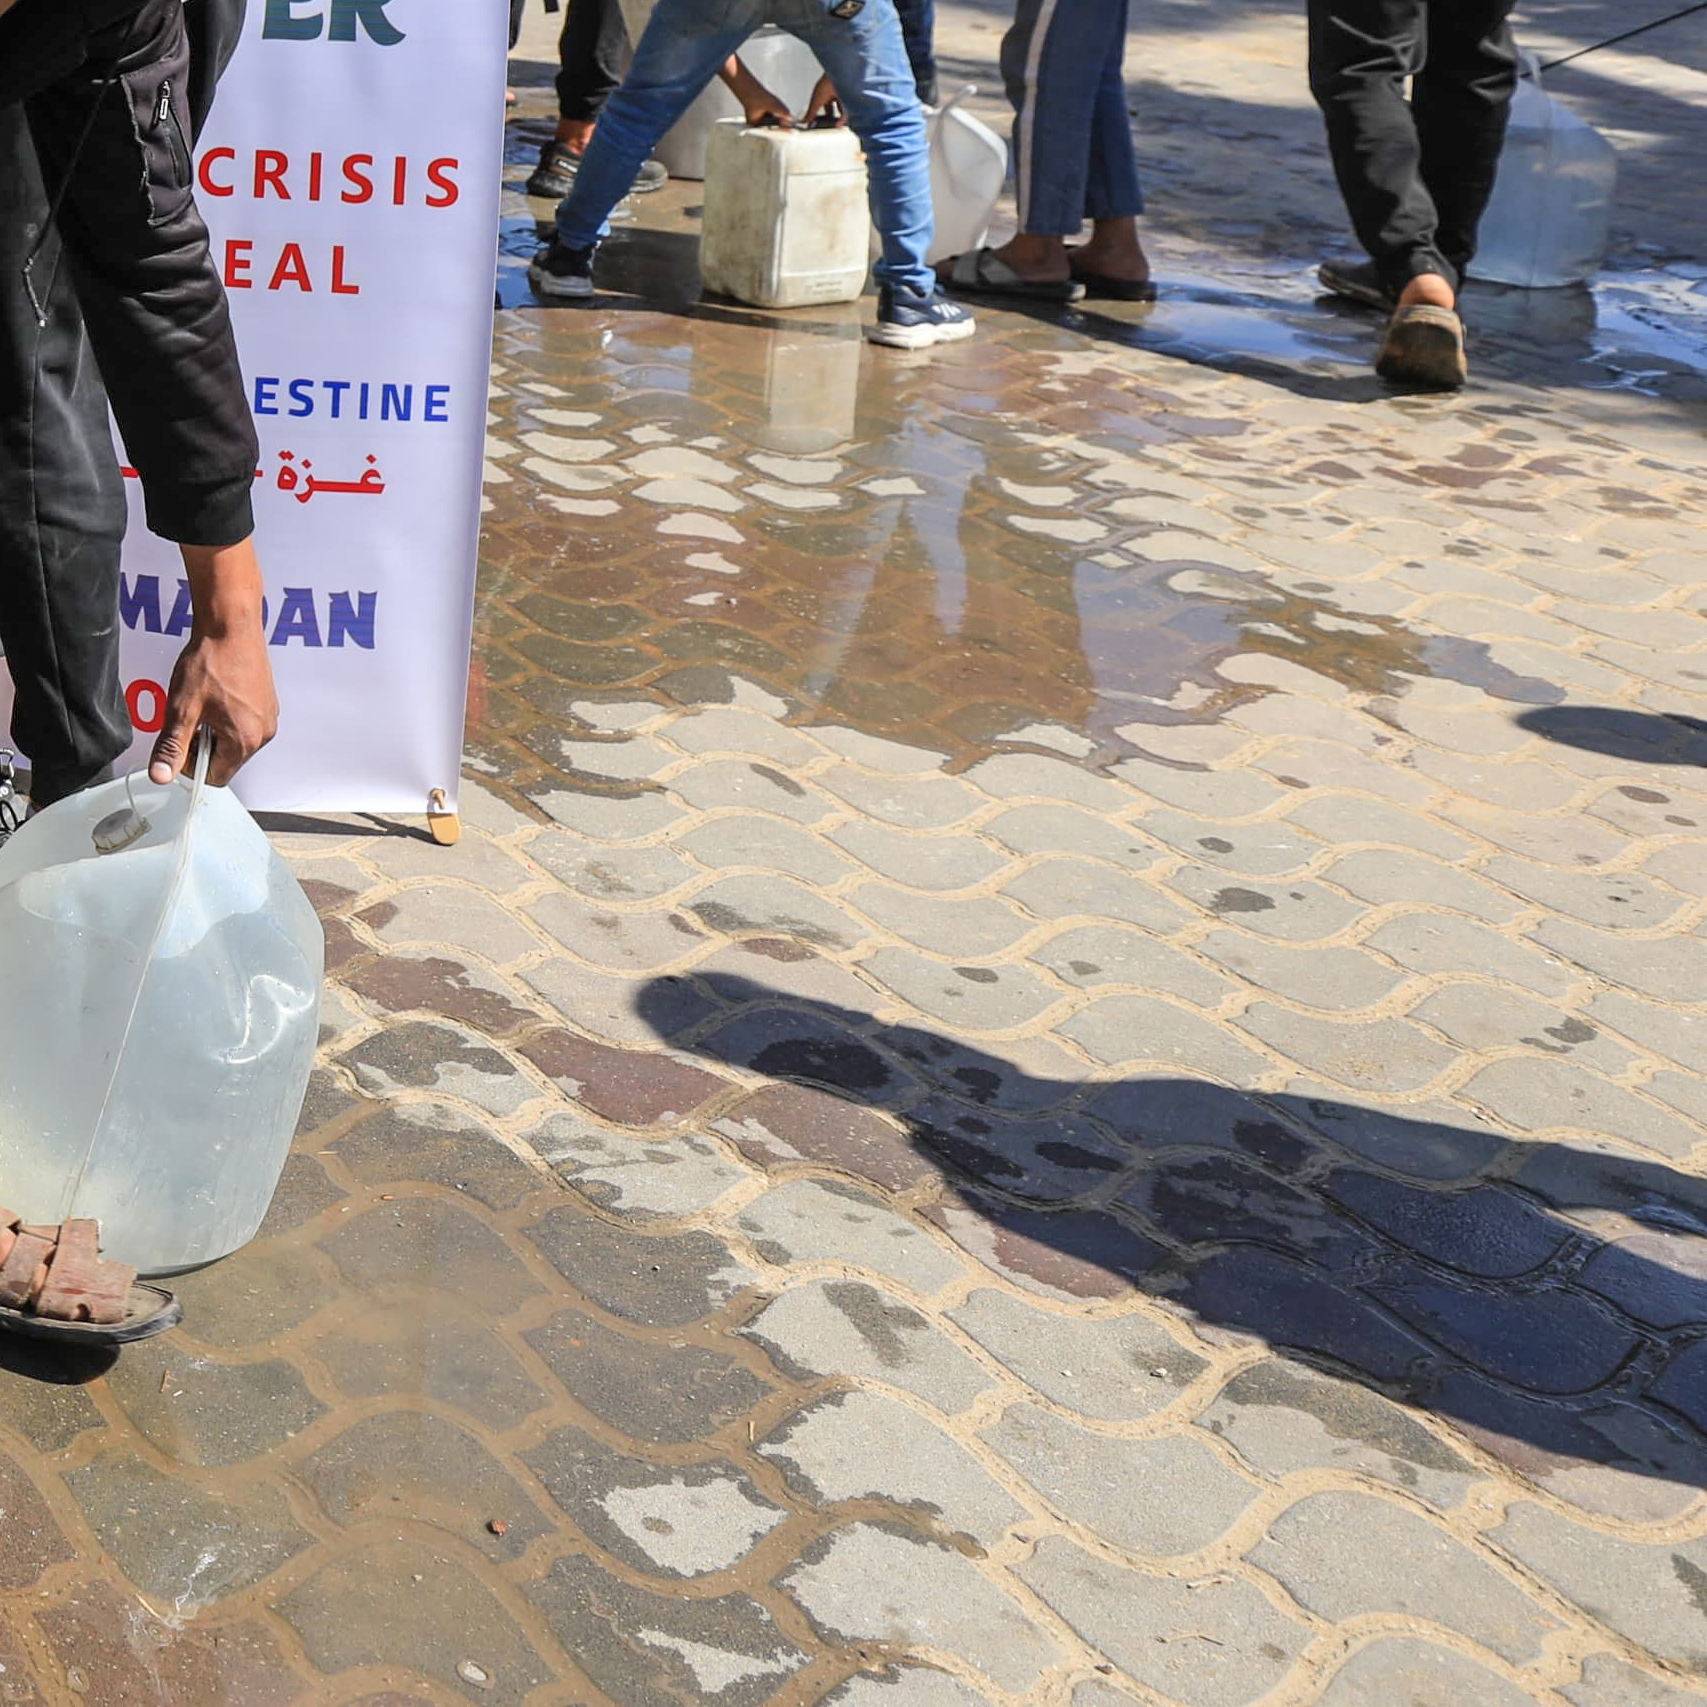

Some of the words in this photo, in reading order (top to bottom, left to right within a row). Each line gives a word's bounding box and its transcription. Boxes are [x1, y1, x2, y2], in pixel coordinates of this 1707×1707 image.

[197, 146, 460, 208] CRISIS
[253, 376, 451, 422] ESTINE
[276, 449, 386, 504] غزة
